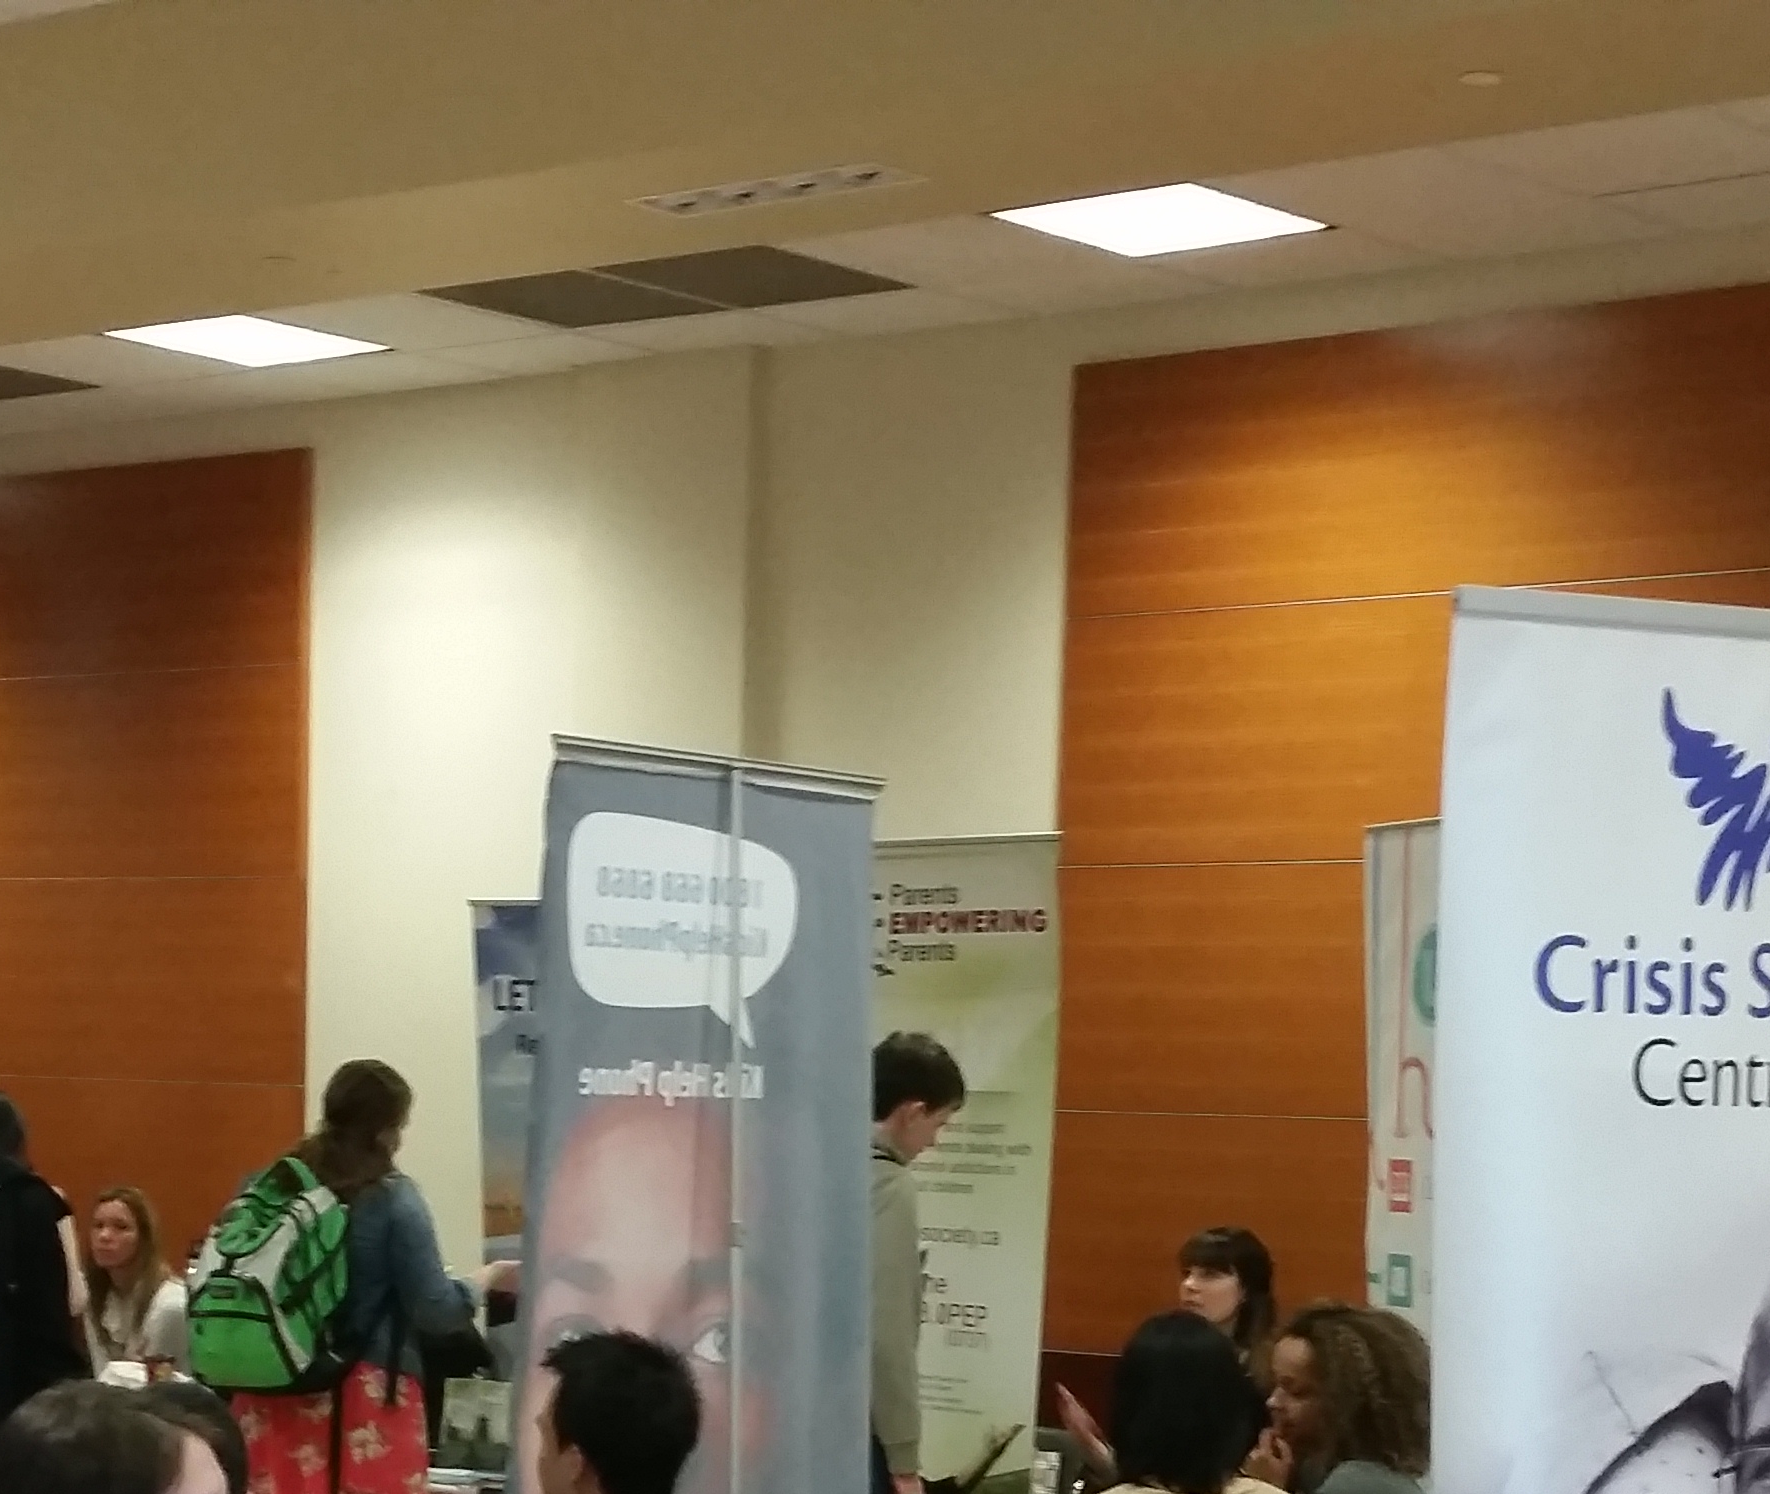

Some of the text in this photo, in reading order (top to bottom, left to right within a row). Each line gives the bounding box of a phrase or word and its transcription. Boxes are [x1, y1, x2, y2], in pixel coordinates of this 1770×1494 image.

[890, 884, 958, 905] Parents
[890, 910, 1047, 934] EMPOWERING
[888, 939, 955, 961] Parents
[1535, 934, 1728, 1019] Crisis
